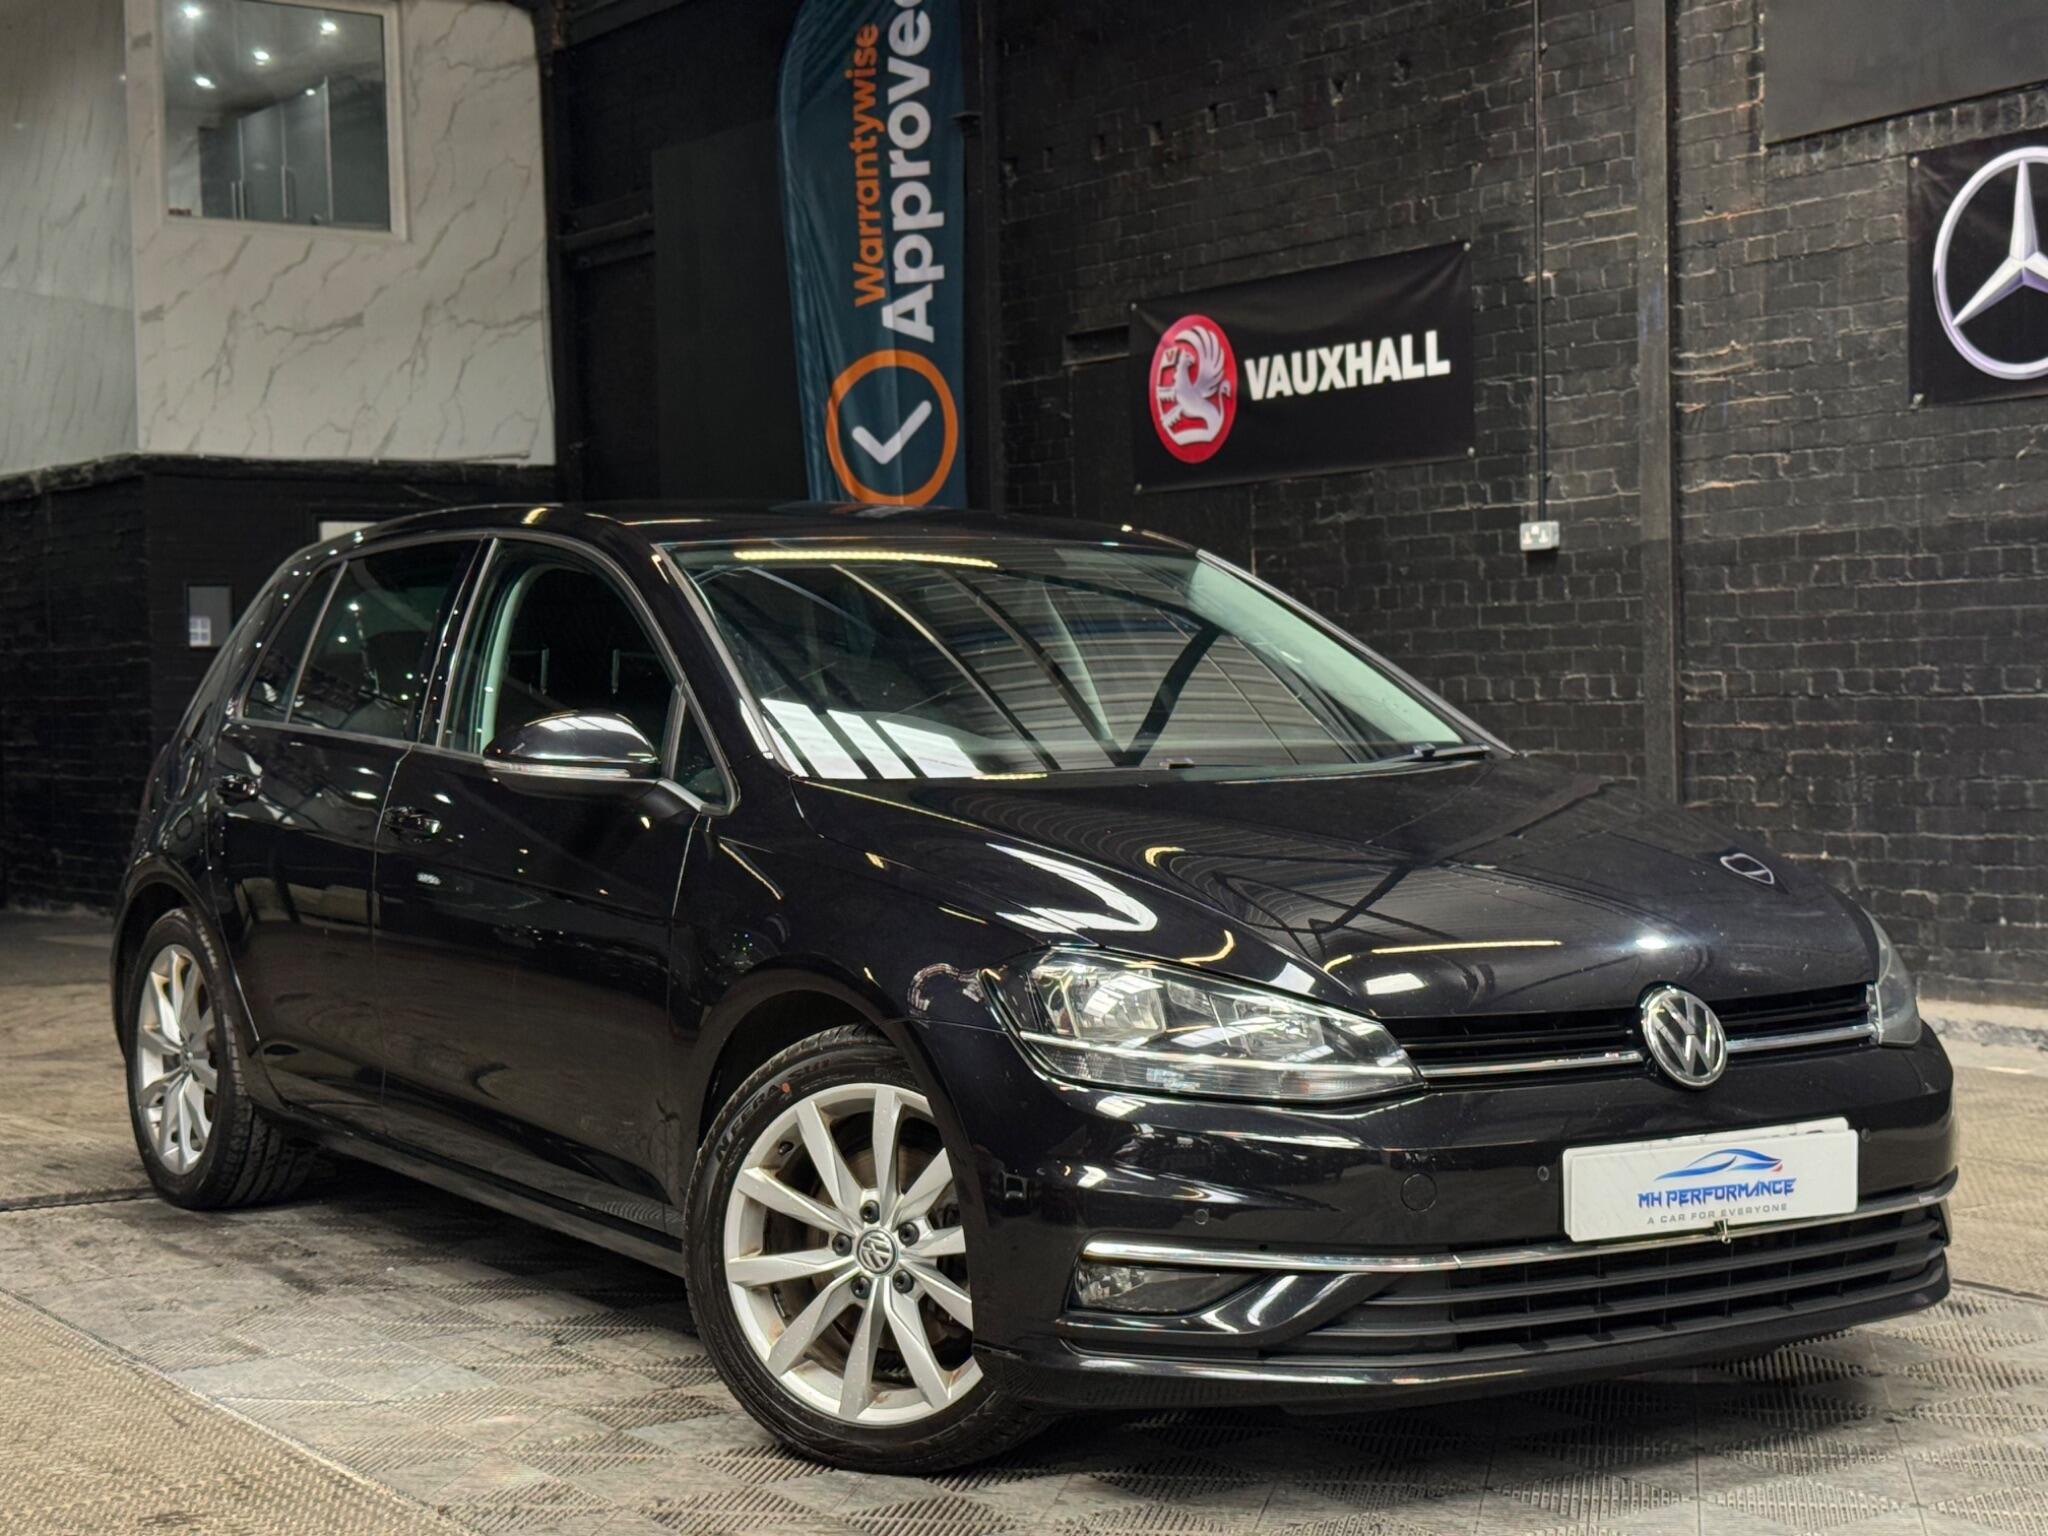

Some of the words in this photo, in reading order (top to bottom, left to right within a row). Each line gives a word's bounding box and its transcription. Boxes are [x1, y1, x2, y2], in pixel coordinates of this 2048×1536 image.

[845, 23, 886, 307] Warrantywise
[881, 0, 945, 342] Approve
[1245, 330, 1450, 400] VAUXHALL
[1645, 988, 1725, 1084] VW
[1637, 1191, 1662, 1209] MH
[1666, 1178, 1797, 1208] PERFORMANCE
[1647, 1217, 1655, 1225] A
[1660, 1213, 1686, 1224] CAR
[1690, 1209, 1716, 1219] FOR
[1720, 1203, 1788, 1217] EVERYONE
